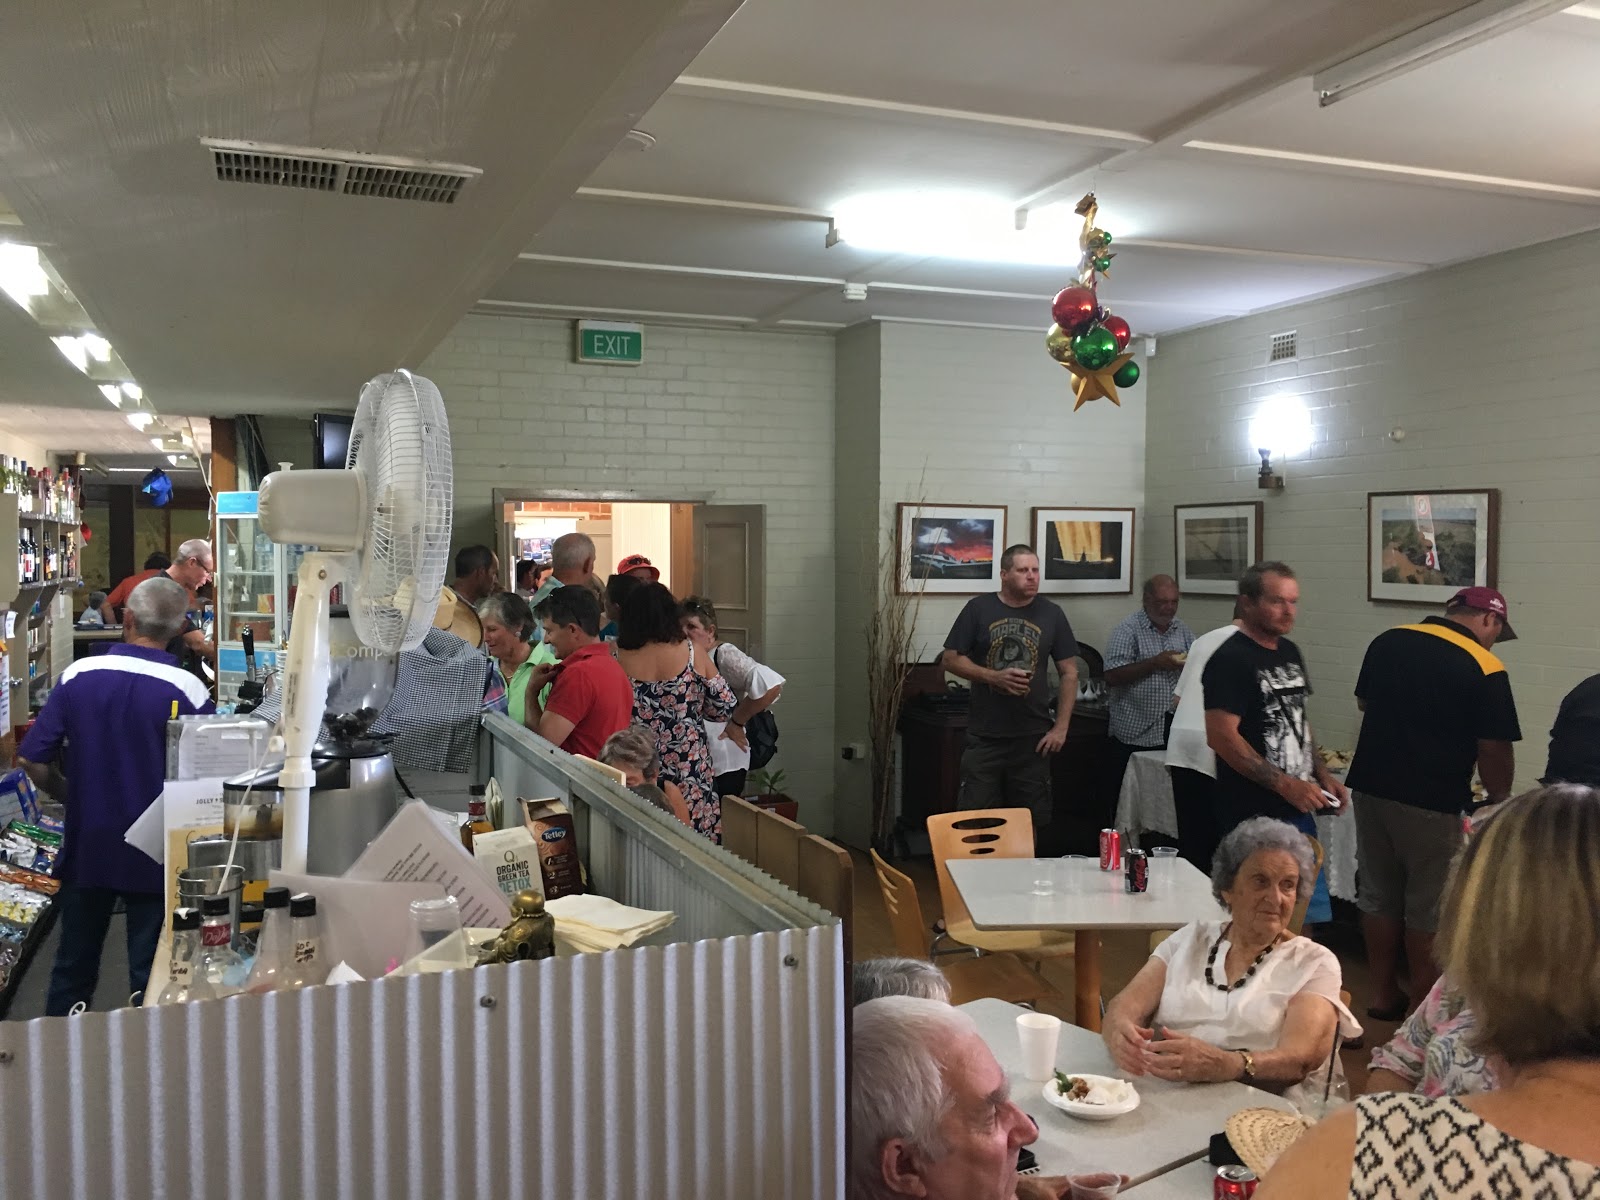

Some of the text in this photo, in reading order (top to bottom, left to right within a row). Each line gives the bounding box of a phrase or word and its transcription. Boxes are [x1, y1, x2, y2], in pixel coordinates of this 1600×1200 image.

[594, 334, 631, 355] EXIT
[990, 623, 1040, 647] MARLEY
[544, 829, 567, 840] Tetley
[496, 860, 529, 875] ORGANIC
[497, 870, 530, 883] GREEN TEA
[499, 877, 532, 893] DETOX
